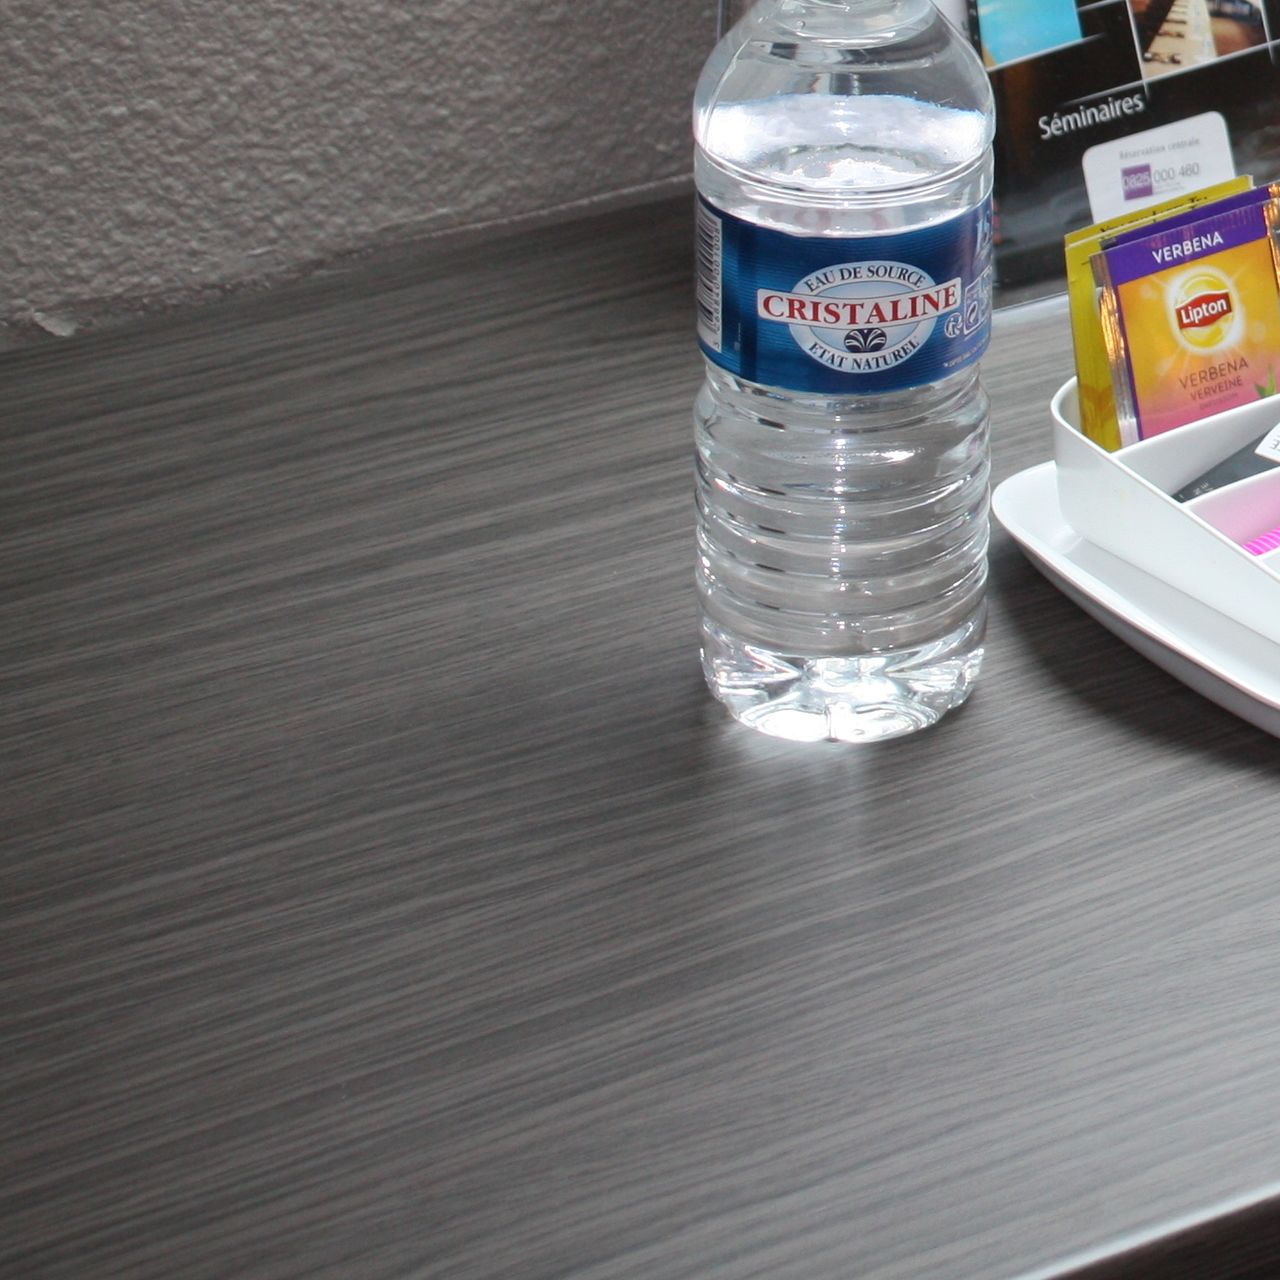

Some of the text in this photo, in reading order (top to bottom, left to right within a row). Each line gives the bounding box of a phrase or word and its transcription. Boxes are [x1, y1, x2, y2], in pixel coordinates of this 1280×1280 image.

[1038, 93, 1145, 141] Séminaires
[1153, 167, 1177, 184] 000
[1152, 231, 1224, 264] VERBENA
[805, 264, 927, 293] EAU DE SOURCE
[762, 282, 958, 327] CRISTALINE
[1180, 297, 1228, 325] Lipton
[807, 341, 845, 369] ETAT
[851, 338, 920, 371] NATUREL
[1178, 356, 1250, 390] VERBENA
[1190, 375, 1243, 402] VERVEINE
